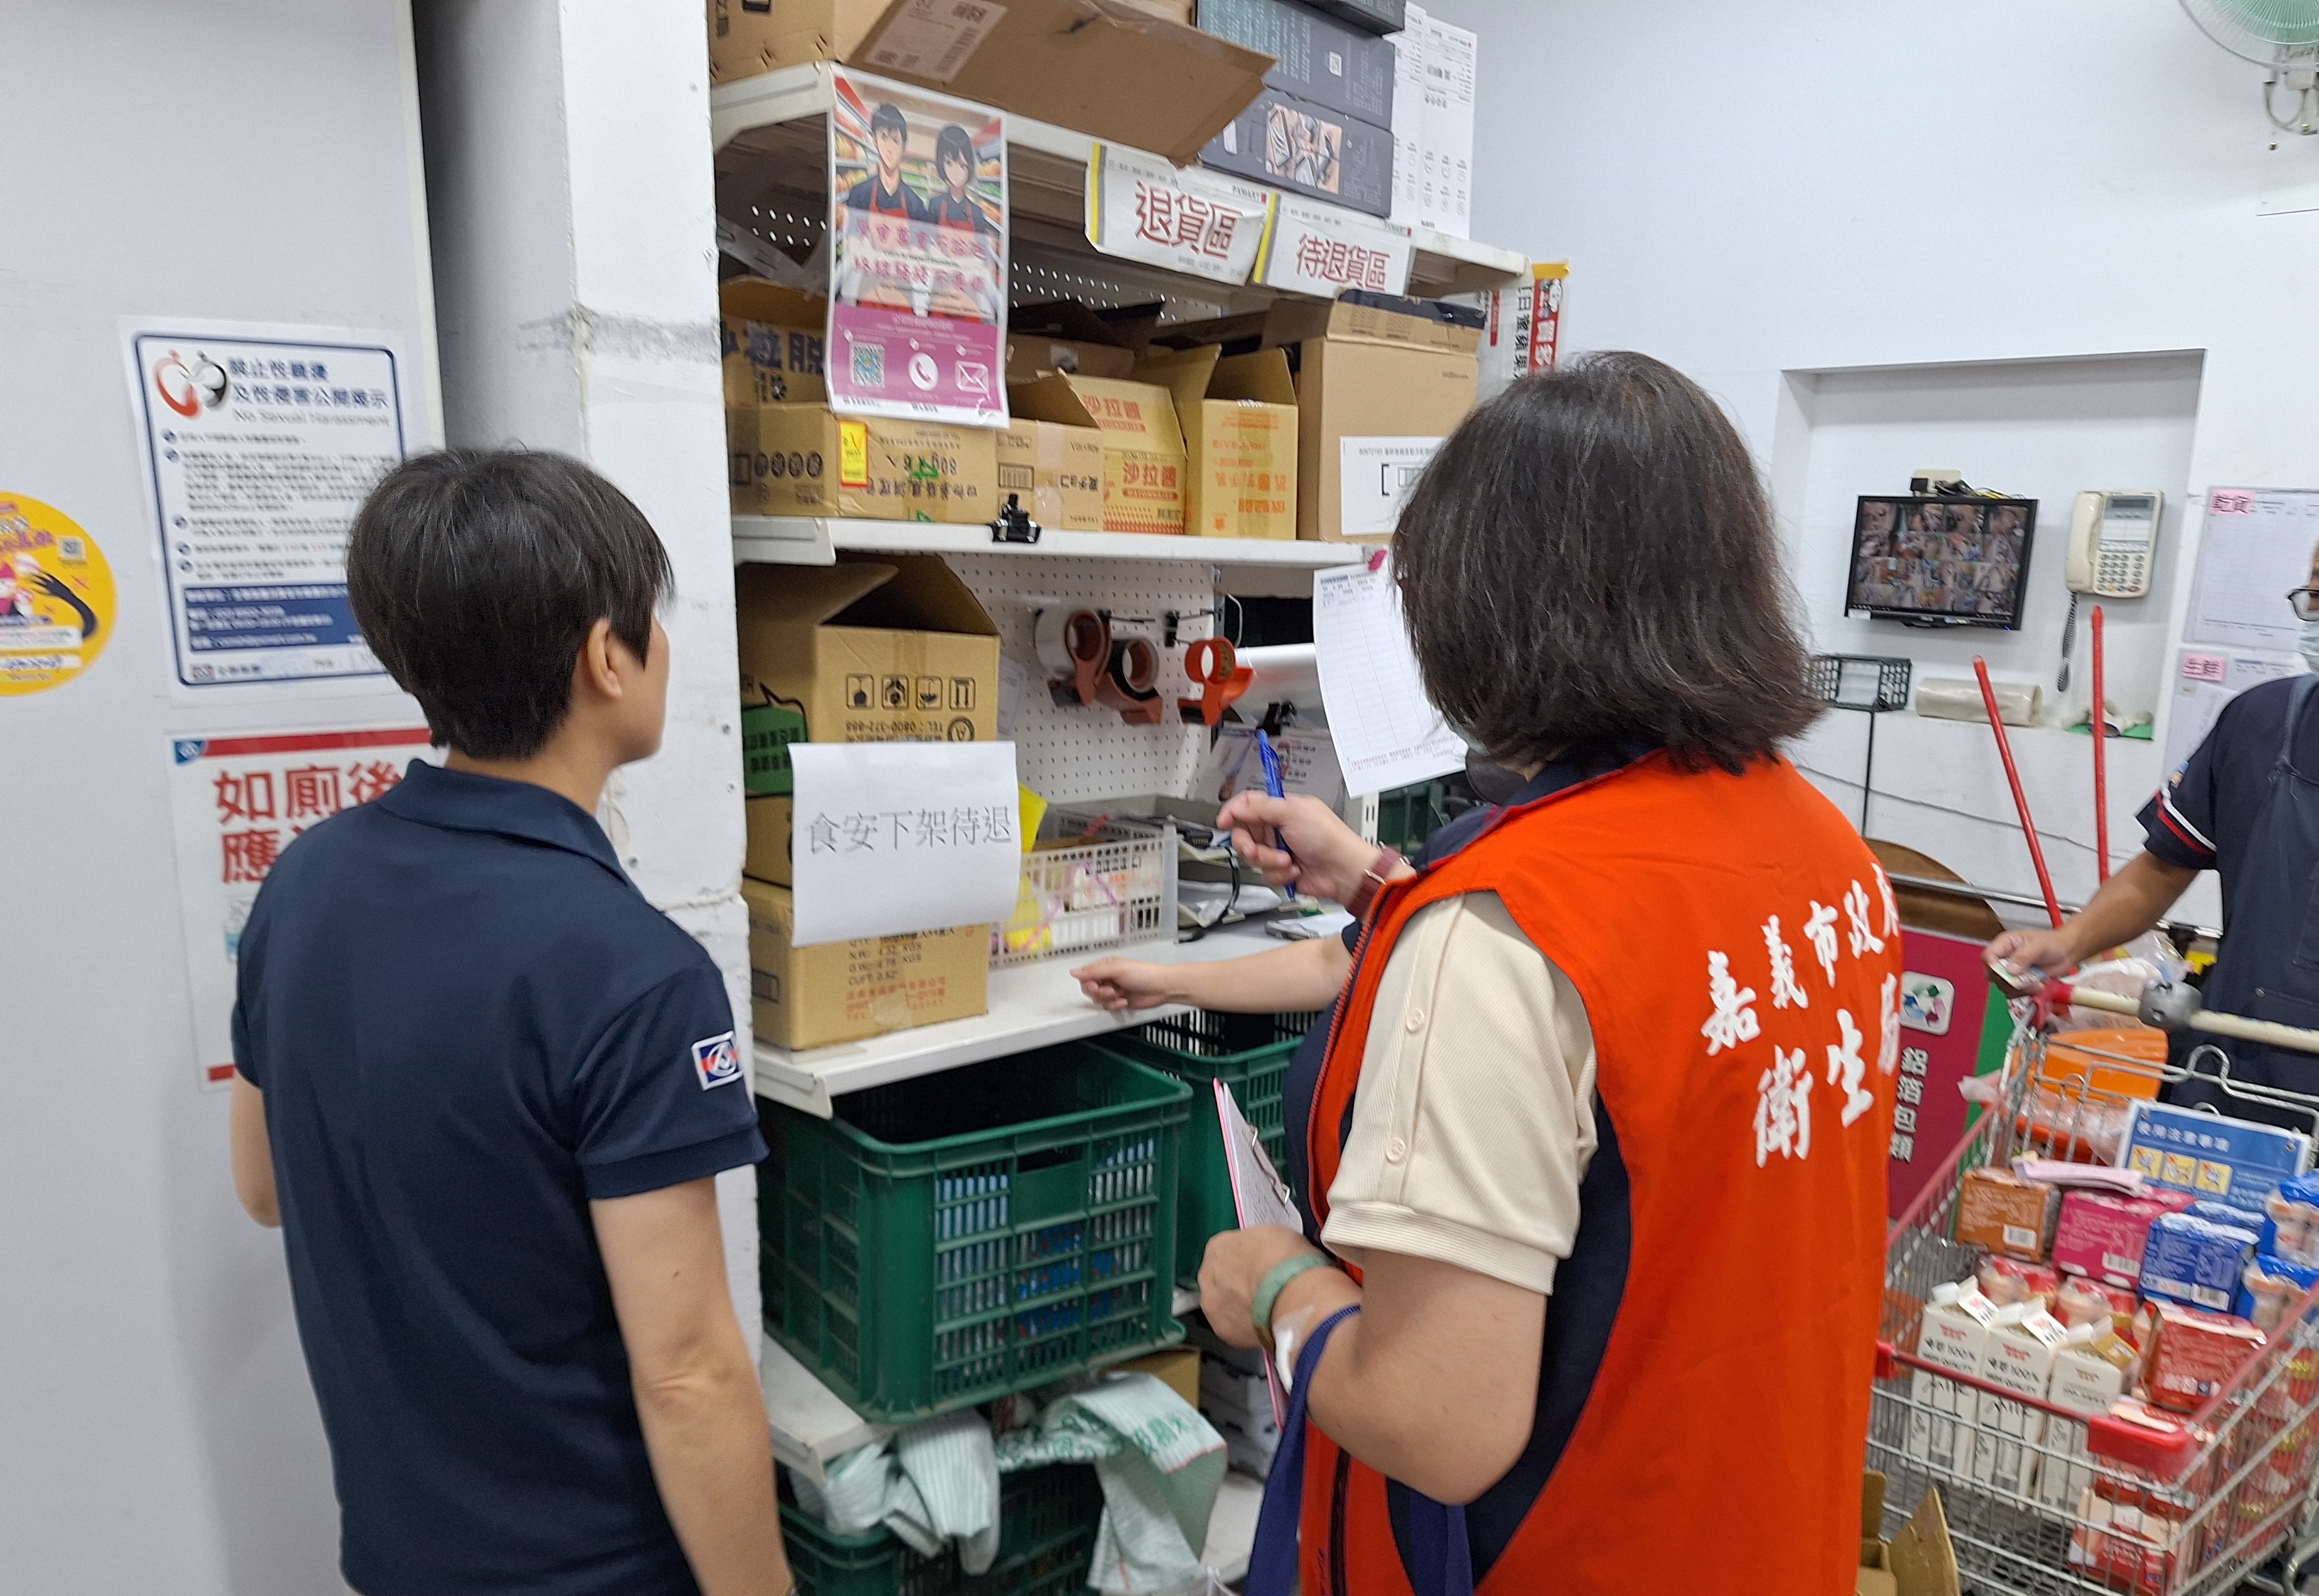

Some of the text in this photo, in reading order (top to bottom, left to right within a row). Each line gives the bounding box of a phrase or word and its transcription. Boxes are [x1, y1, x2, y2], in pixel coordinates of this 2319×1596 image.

[1134, 179, 1245, 261] 退貨區
[1296, 233, 1391, 292] 待退貨區
[1122, 461, 1177, 490] 沙拉醬
[214, 761, 403, 825] 如廁後
[805, 806, 1011, 854] 食安下架待退
[2136, 1119, 2230, 1153] 使用注意事項
